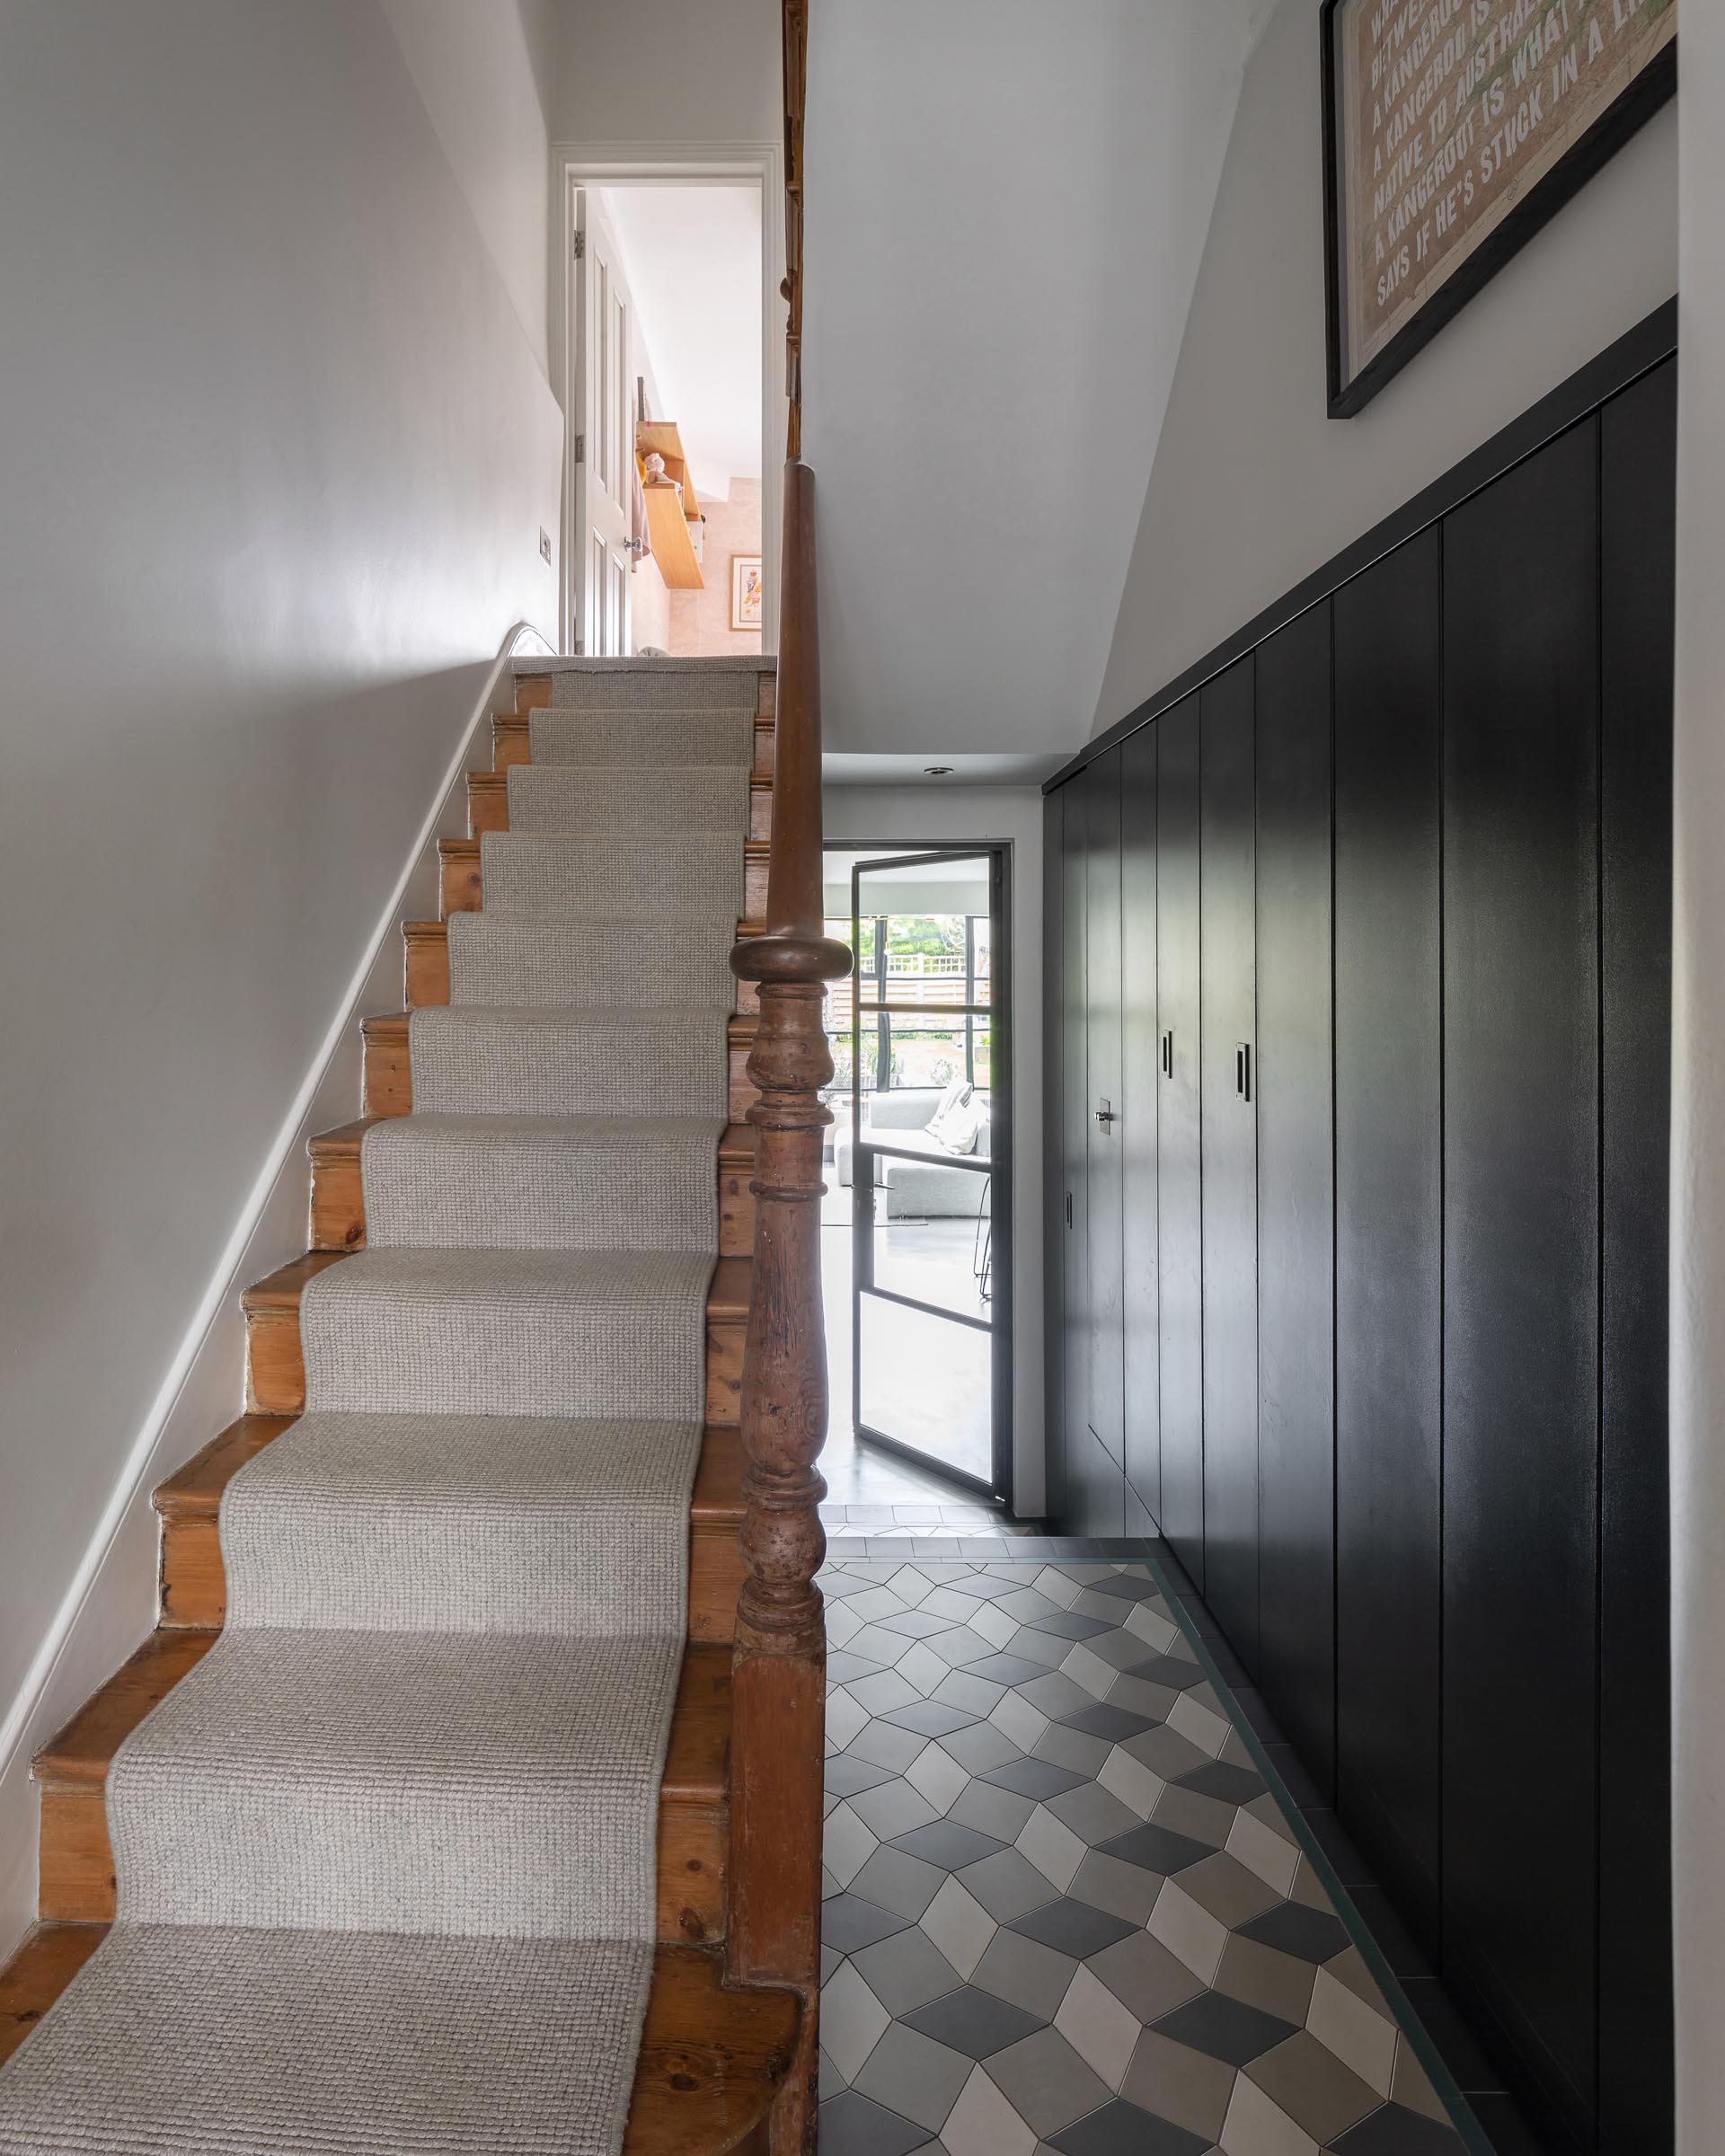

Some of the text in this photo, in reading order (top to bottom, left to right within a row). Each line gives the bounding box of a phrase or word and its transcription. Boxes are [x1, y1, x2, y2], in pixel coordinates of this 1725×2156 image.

[1372, 101, 1382, 136] A
[1373, 144, 1381, 179] A
[1374, 0, 1542, 220] NATIVE TO AUSTRAL
[1376, 230, 1384, 266] A
[1482, 75, 1505, 128] IS
[1512, 0, 1569, 89] WHAT
[1377, 16, 1605, 306] SAYS IF HE'S STUCK IN A
